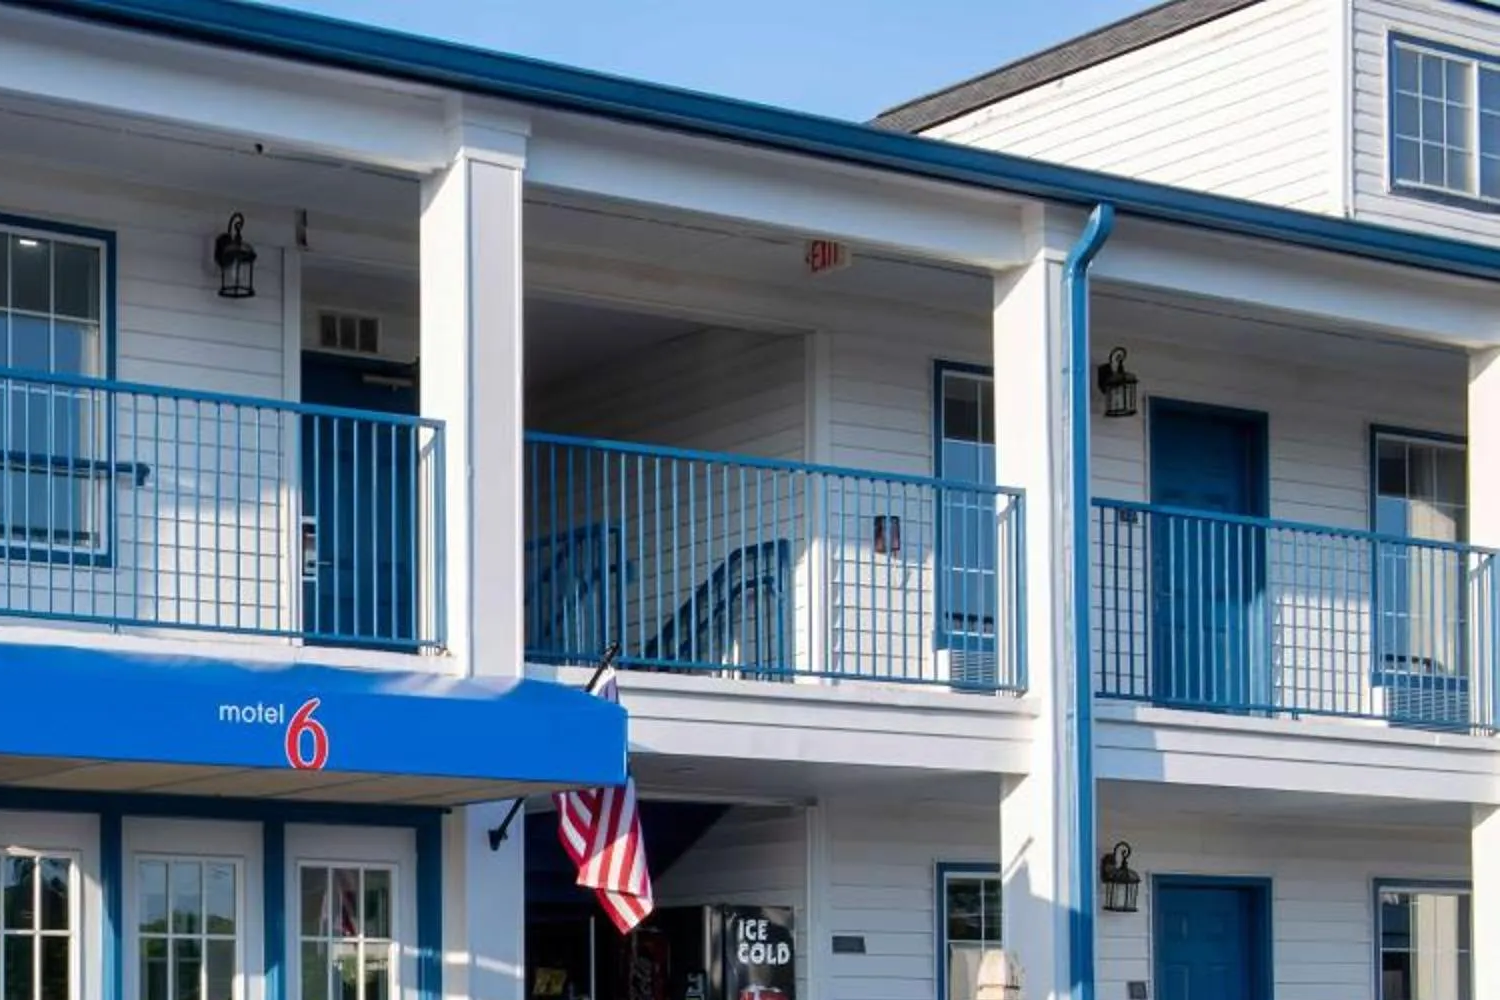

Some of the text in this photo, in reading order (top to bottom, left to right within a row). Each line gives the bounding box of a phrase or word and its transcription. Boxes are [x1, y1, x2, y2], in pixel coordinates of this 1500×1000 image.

[219, 697, 329, 769] motel 6
[738, 918, 769, 941] ICE
[737, 942, 791, 965] COLD
